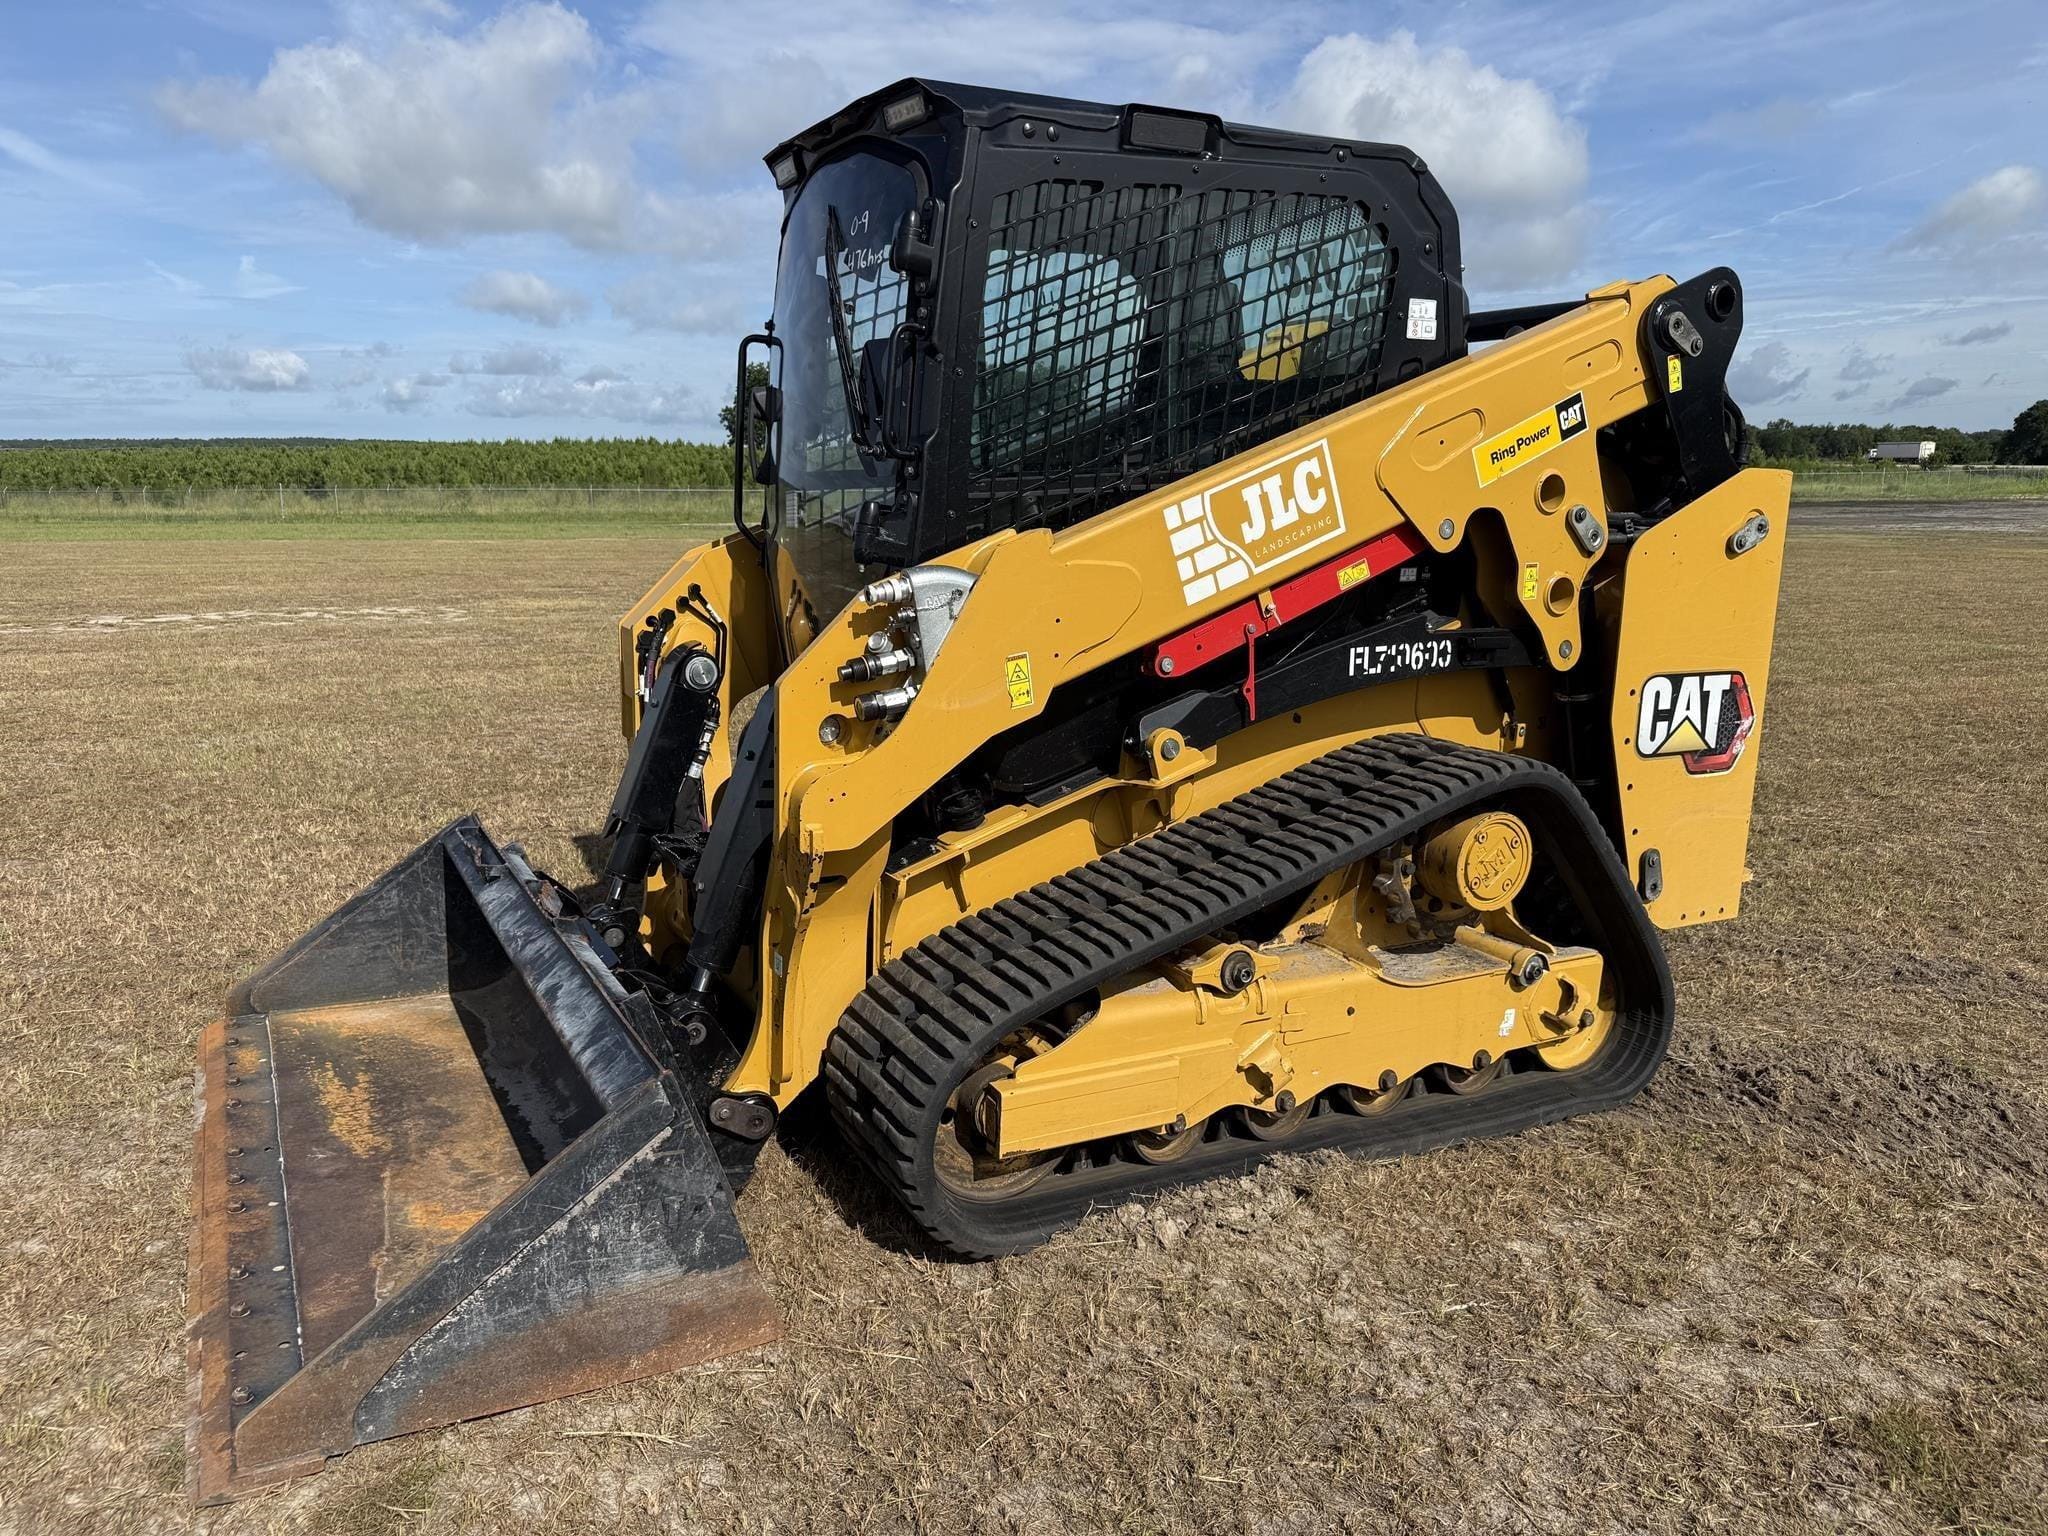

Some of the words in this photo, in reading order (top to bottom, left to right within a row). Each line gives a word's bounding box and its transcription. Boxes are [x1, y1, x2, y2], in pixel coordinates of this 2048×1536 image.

[1559, 402, 1582, 431] CAT
[1490, 445, 1516, 465] Ring
[1516, 425, 1551, 451] Power
[1241, 456, 1327, 545] JLC
[1255, 516, 1332, 558] LANDSCAPING
[1638, 674, 1732, 755] CAT
